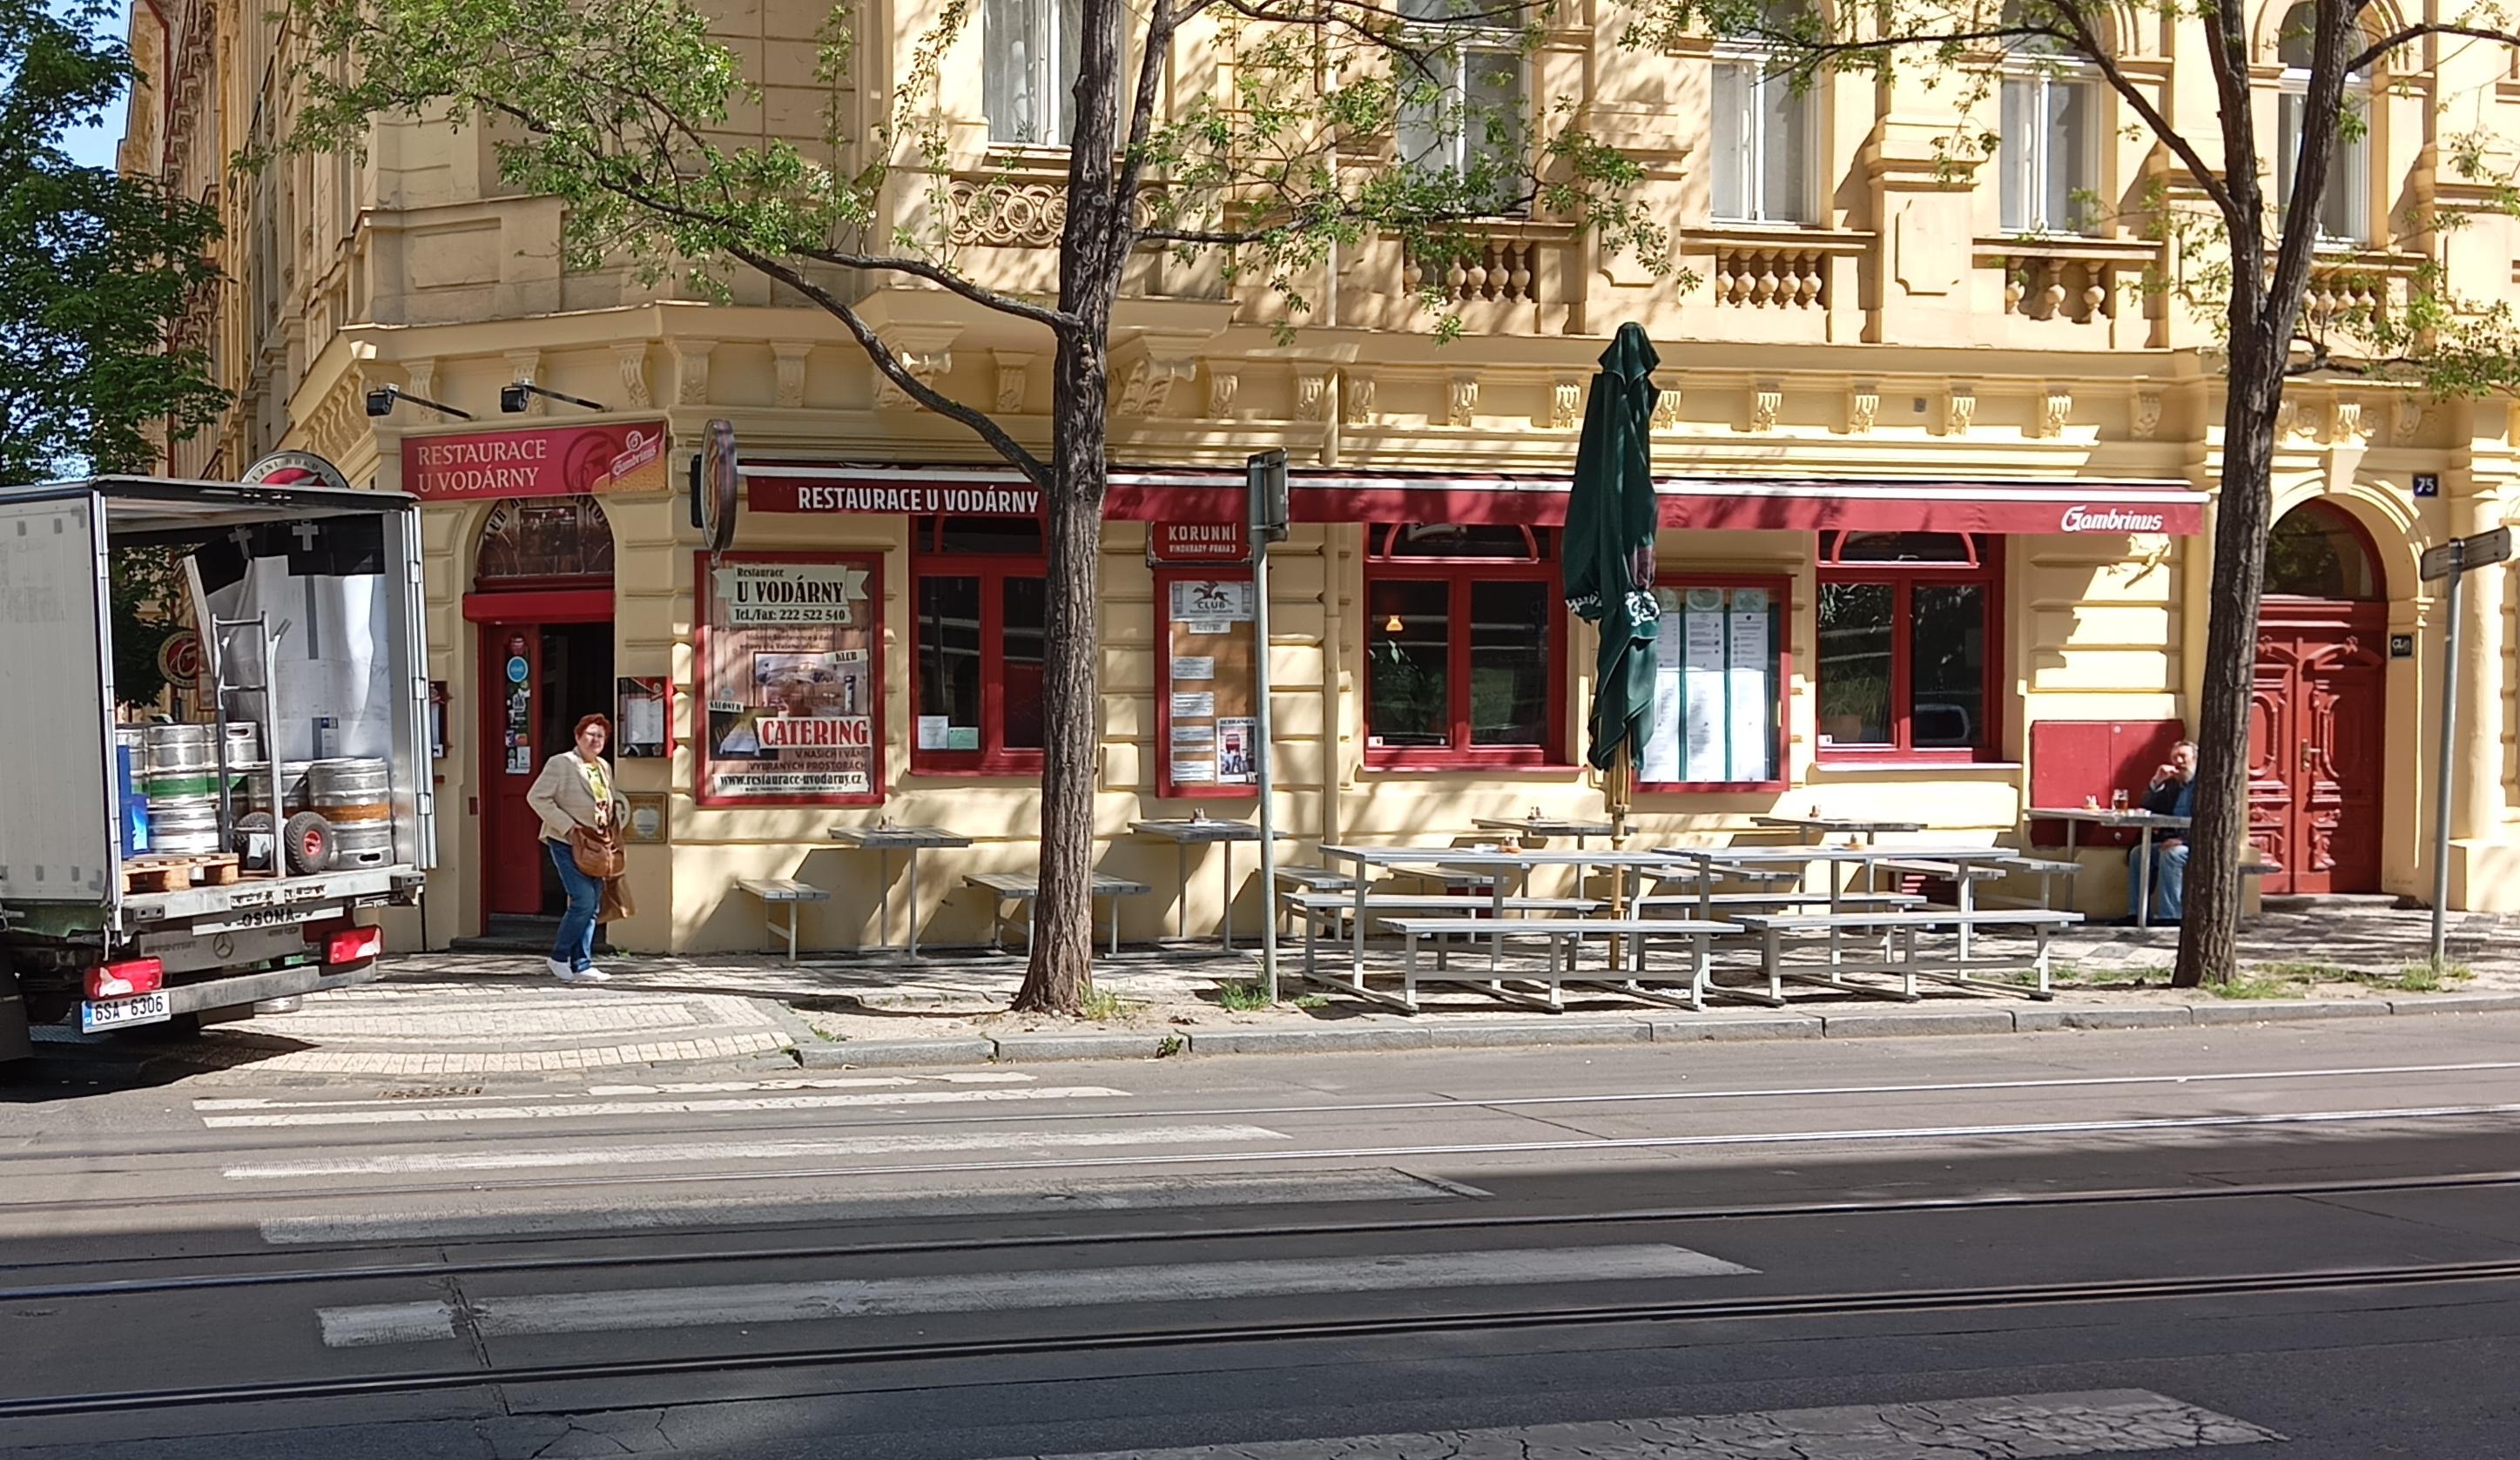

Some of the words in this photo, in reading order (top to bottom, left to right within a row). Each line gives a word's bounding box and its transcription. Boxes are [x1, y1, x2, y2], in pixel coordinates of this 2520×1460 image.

[418, 439, 547, 466] RESTAURACE
[418, 473, 432, 492] U
[436, 465, 540, 492] VODÁRNY
[2417, 477, 2435, 493] 75
[798, 487, 922, 511] RESTAURACE
[926, 489, 939, 511] U
[944, 485, 1039, 513] VODÁRNY
[2060, 505, 2164, 532] Gambrinus
[1169, 522, 1236, 541] KORUNNÍ
[737, 568, 785, 577] Restaurace
[737, 581, 748, 602] U
[756, 575, 843, 603] VODÁRNY
[779, 609, 799, 621] 222
[802, 609, 822, 621] 522
[1197, 601, 1225, 609] CLUB
[762, 720, 868, 746] CATERING
[795, 750, 801, 758] V
[720, 774, 862, 786] www.restaurace-uvodarny.cz
[95, 1000, 120, 1021] 6SA
[130, 996, 164, 1016] 6306
